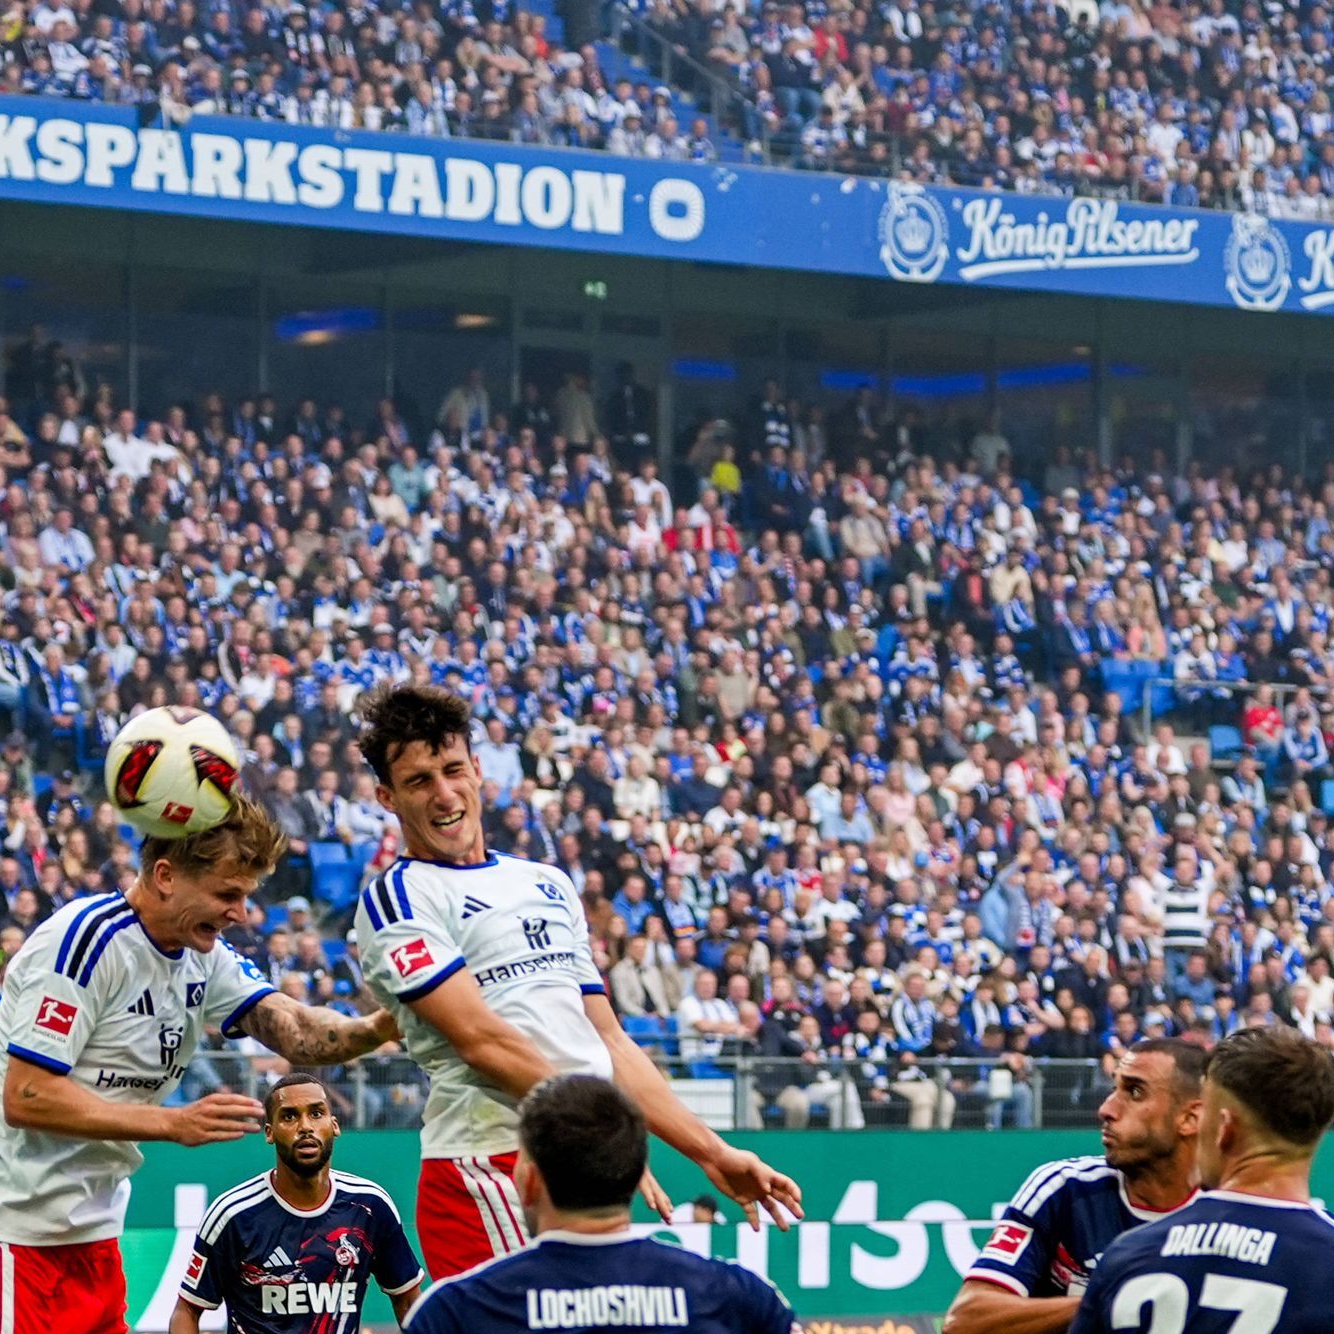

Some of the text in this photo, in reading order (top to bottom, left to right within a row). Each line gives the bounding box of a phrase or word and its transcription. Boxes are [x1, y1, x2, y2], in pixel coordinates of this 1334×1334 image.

[1159, 1222, 1278, 1267] DALLINGA
[261, 1281, 358, 1316] REWE
[526, 1285, 689, 1330] LOCHOSHVILI
